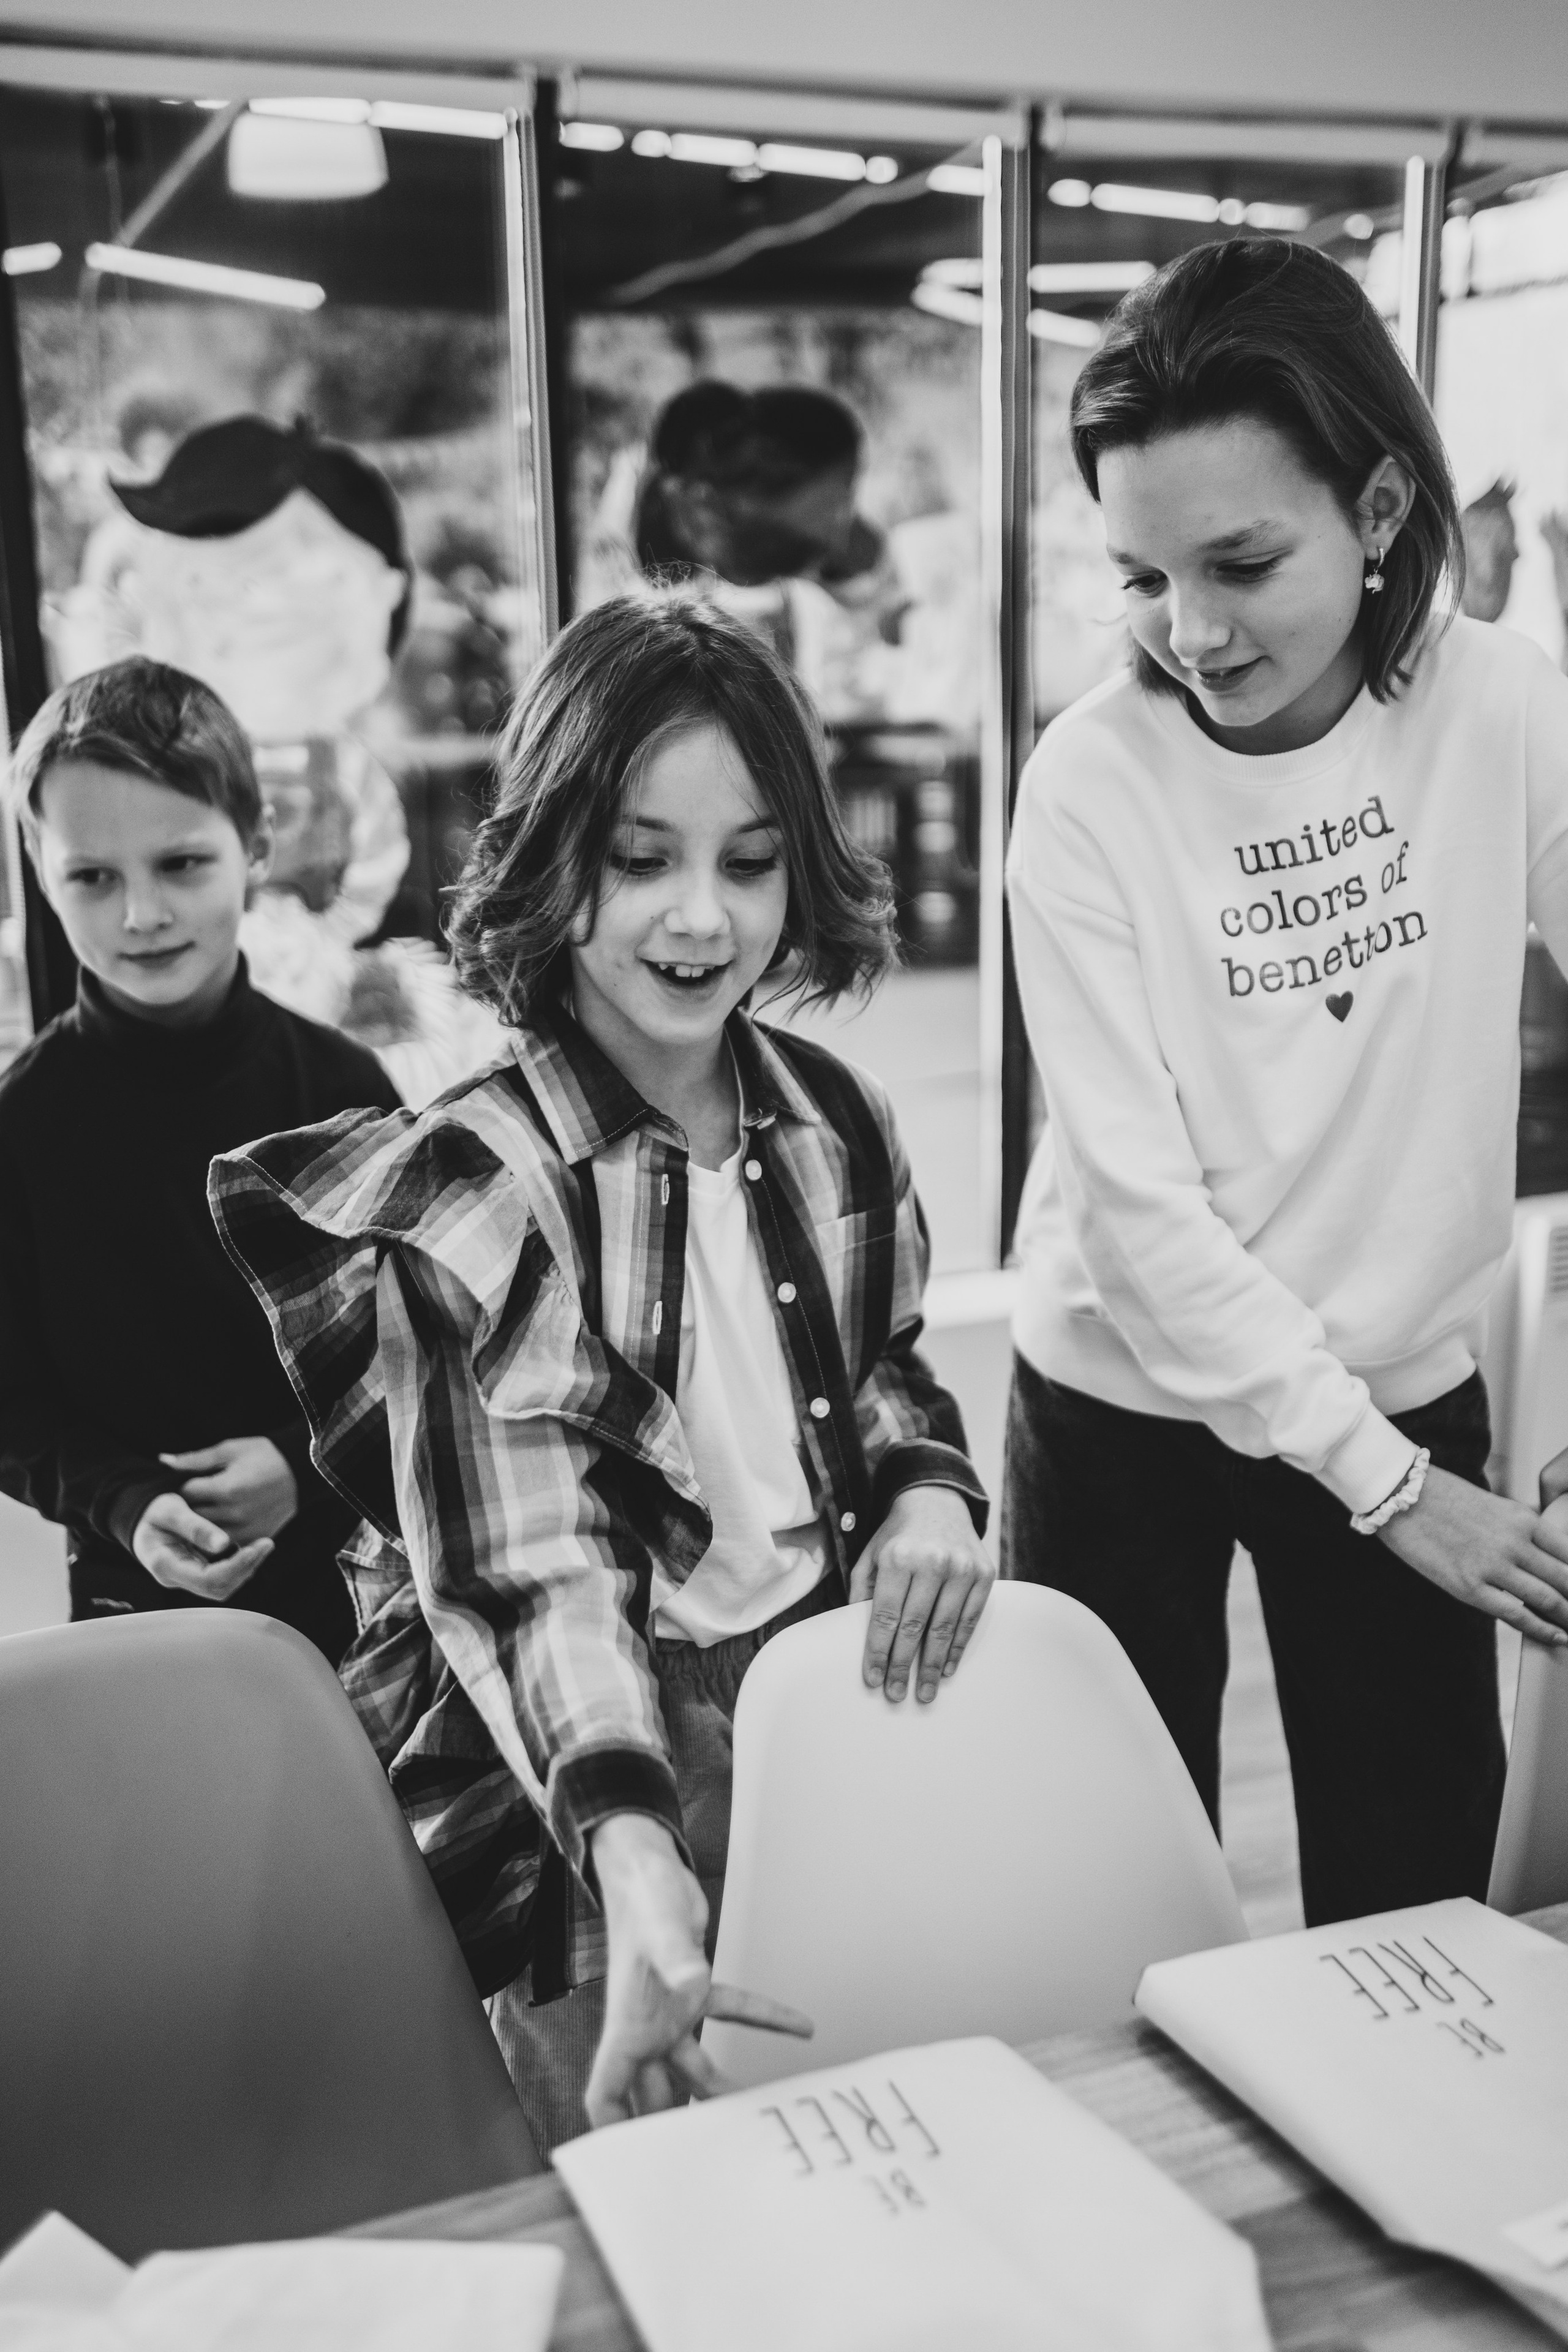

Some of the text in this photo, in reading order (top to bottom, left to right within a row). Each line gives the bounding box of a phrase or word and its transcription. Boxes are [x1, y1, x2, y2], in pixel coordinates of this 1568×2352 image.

[1234, 795, 1395, 875] united
[1220, 840, 1409, 937] colors of
[1221, 911, 1428, 997] benetton
[1319, 1936, 1494, 2020] FREE
[1436, 2018, 1506, 2057] BE
[759, 2079, 941, 2176] FREE
